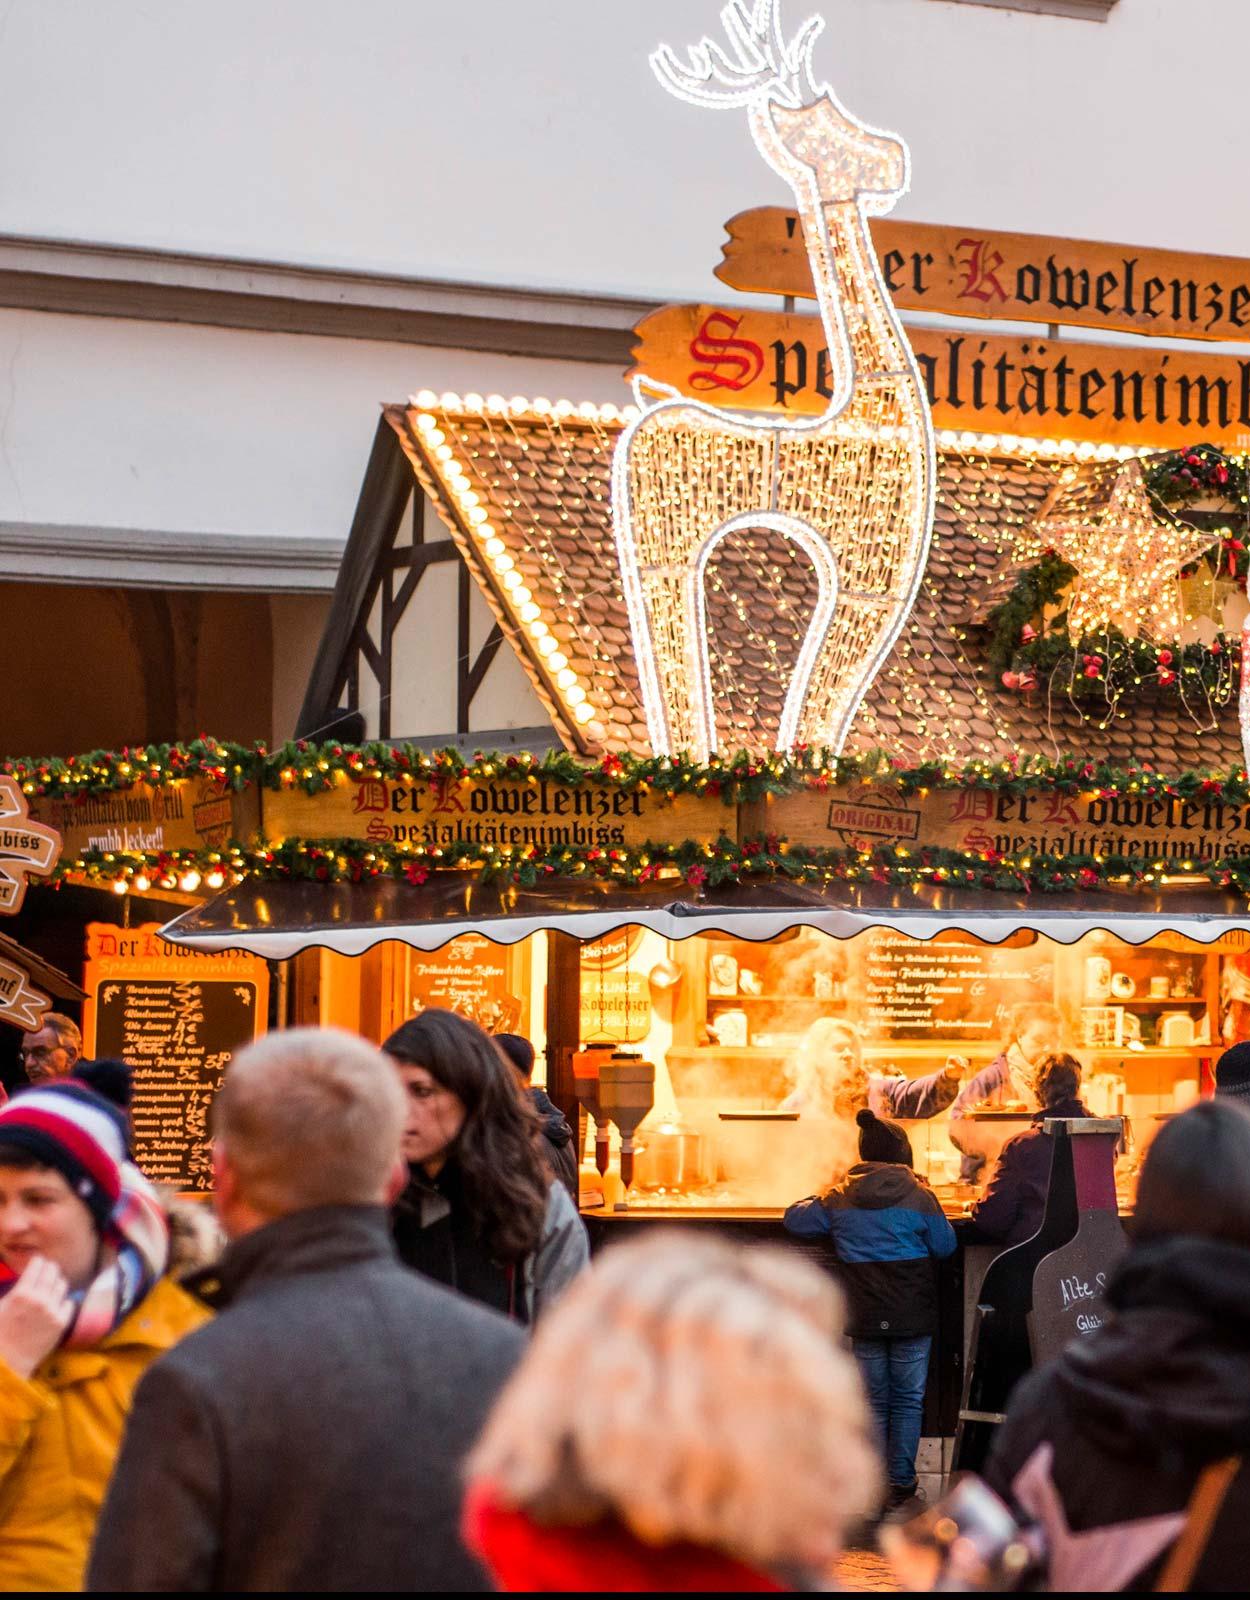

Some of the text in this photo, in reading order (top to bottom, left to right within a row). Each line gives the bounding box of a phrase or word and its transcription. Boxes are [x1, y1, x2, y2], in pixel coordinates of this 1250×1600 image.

[352, 776, 649, 823] Der Kowelenzer
[950, 789, 1038, 824] Der
[366, 817, 625, 847] Spezialitätenimbiss
[833, 808, 914, 834] ORIGINAL
[0, 831, 40, 850] biss
[97, 934, 138, 957] Der
